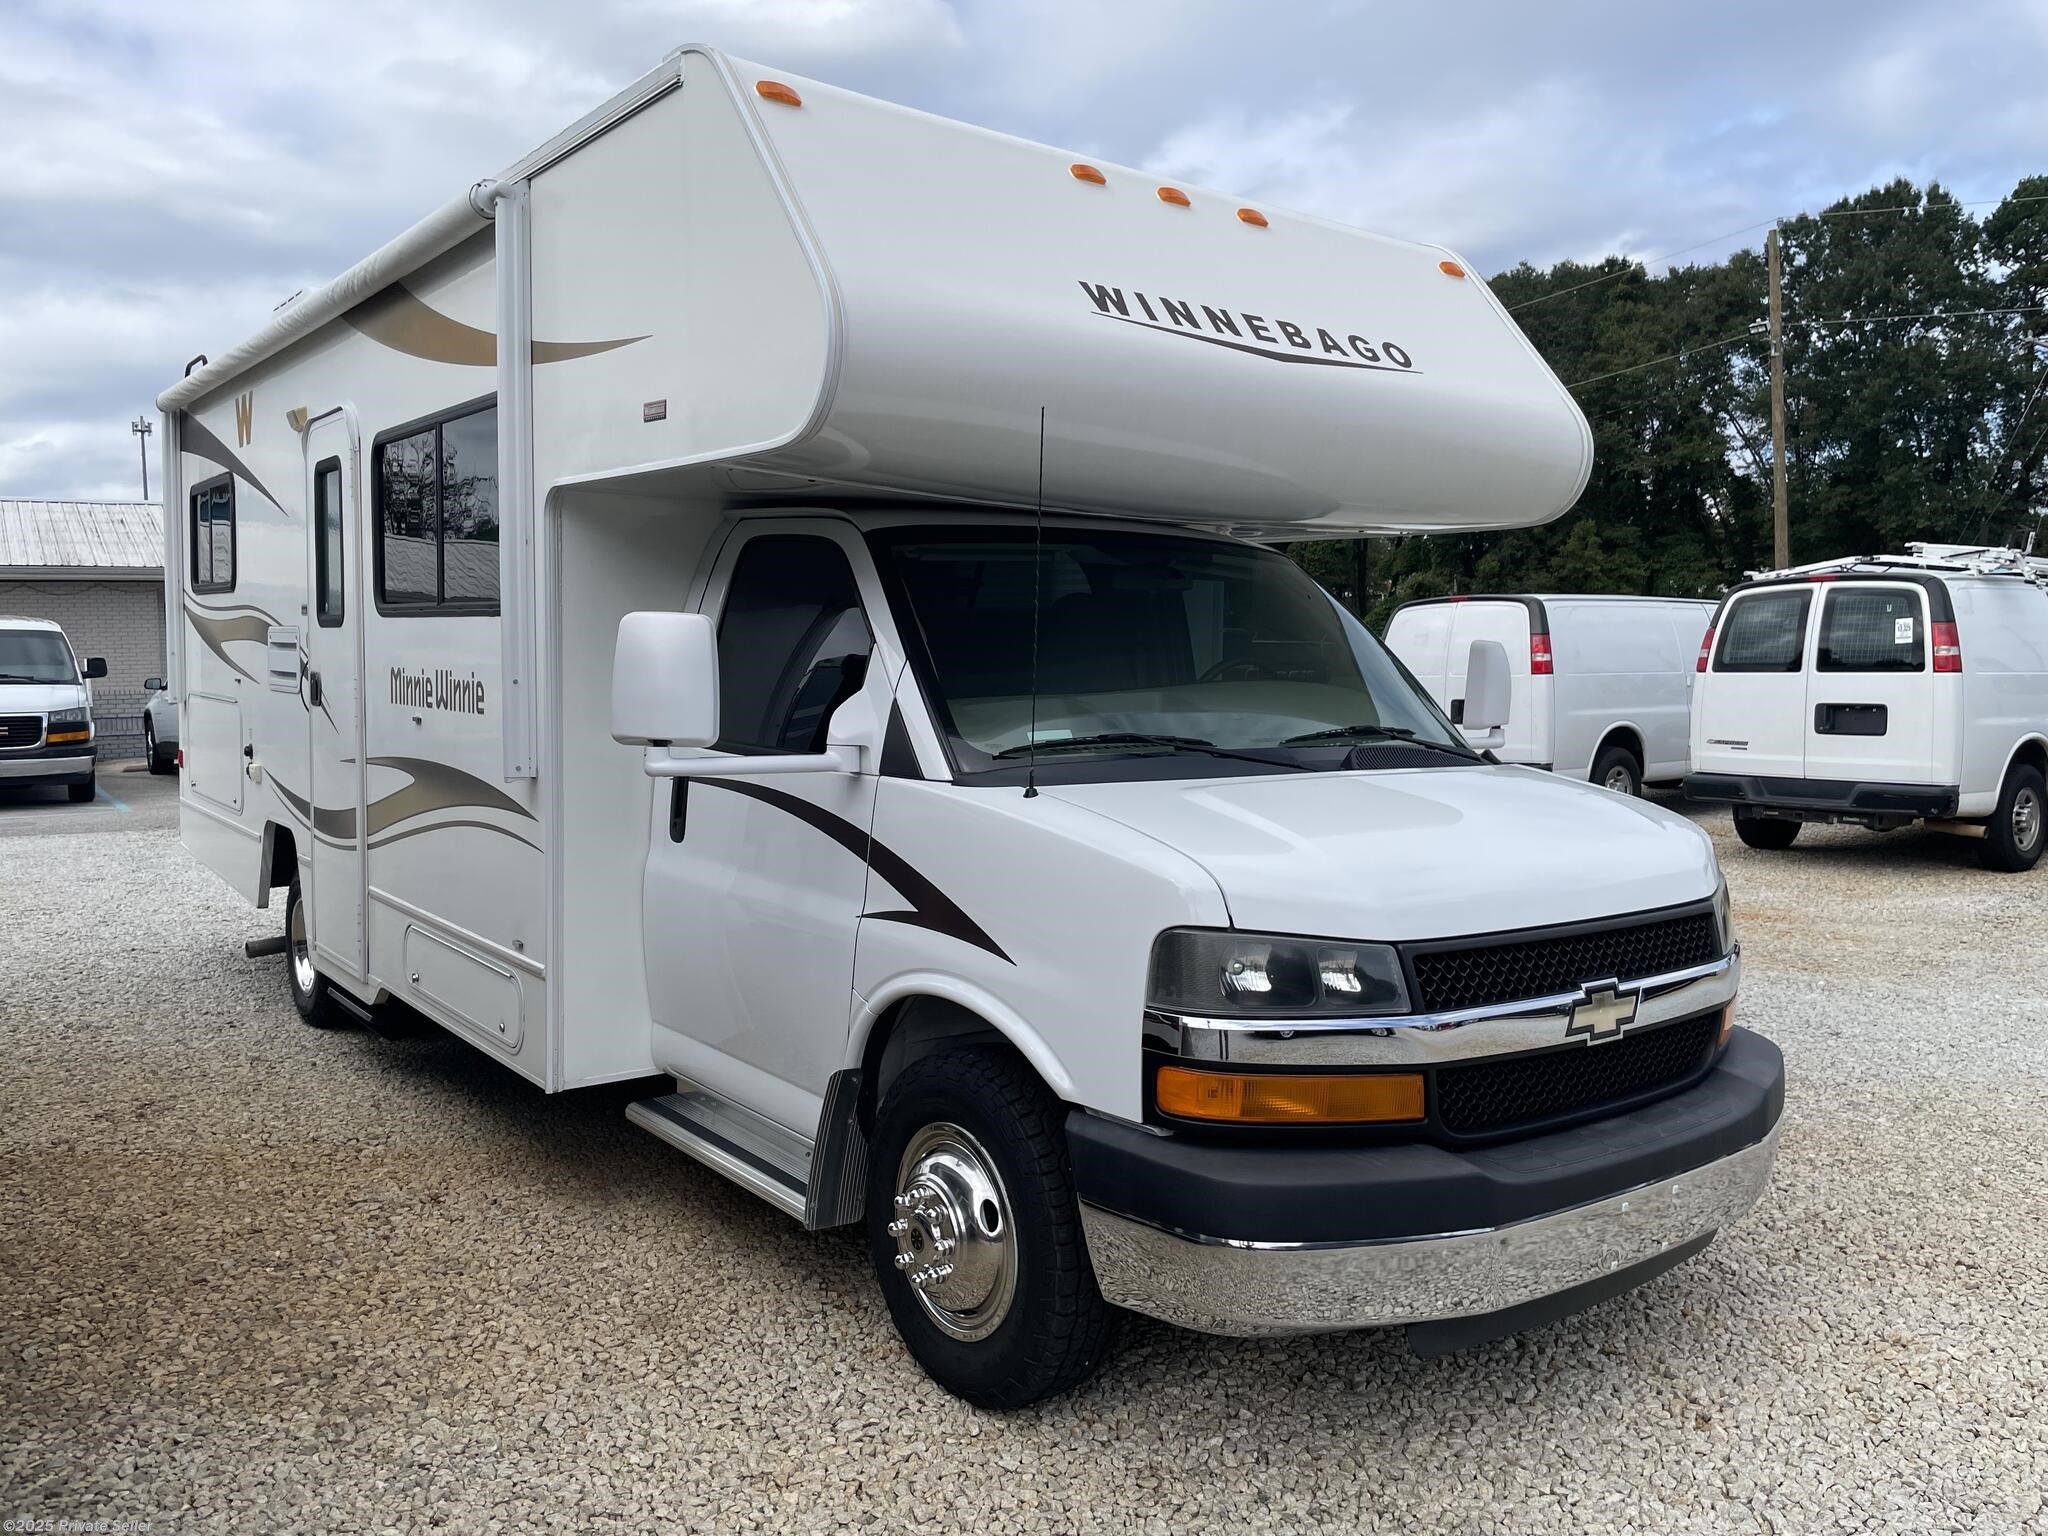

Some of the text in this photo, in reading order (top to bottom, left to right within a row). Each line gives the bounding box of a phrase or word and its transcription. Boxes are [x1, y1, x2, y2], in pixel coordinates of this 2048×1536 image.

[1078, 280, 1413, 369] WINNEBAGO
[235, 390, 254, 448] W
[390, 666, 485, 715] Minnie Winnie
